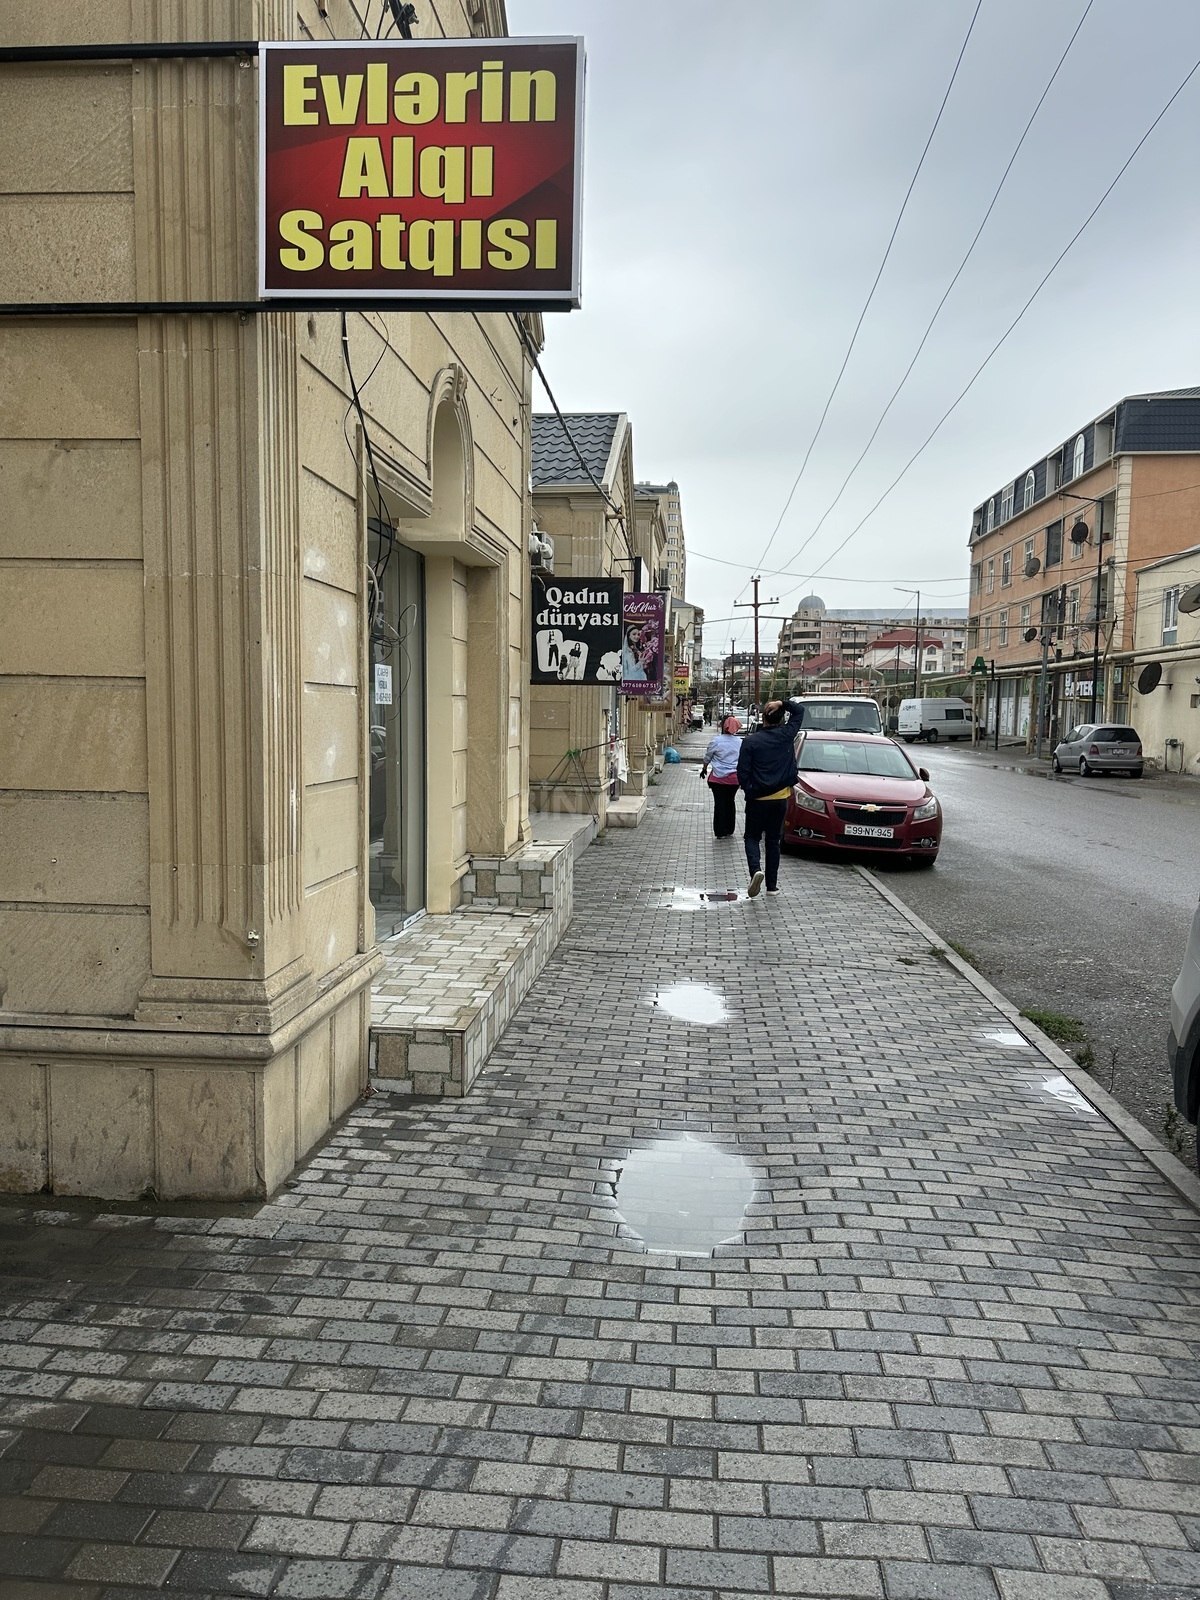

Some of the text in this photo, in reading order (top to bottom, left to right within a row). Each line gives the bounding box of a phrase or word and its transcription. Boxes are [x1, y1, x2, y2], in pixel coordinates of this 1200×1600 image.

[282, 60, 557, 126] Evlərin
[338, 135, 494, 204] Alqı
[278, 209, 558, 277] Satqısı
[536, 608, 619, 630] dünyası
[545, 586, 610, 608] Qadın
[852, 826, 892, 838] 99-NY-945
